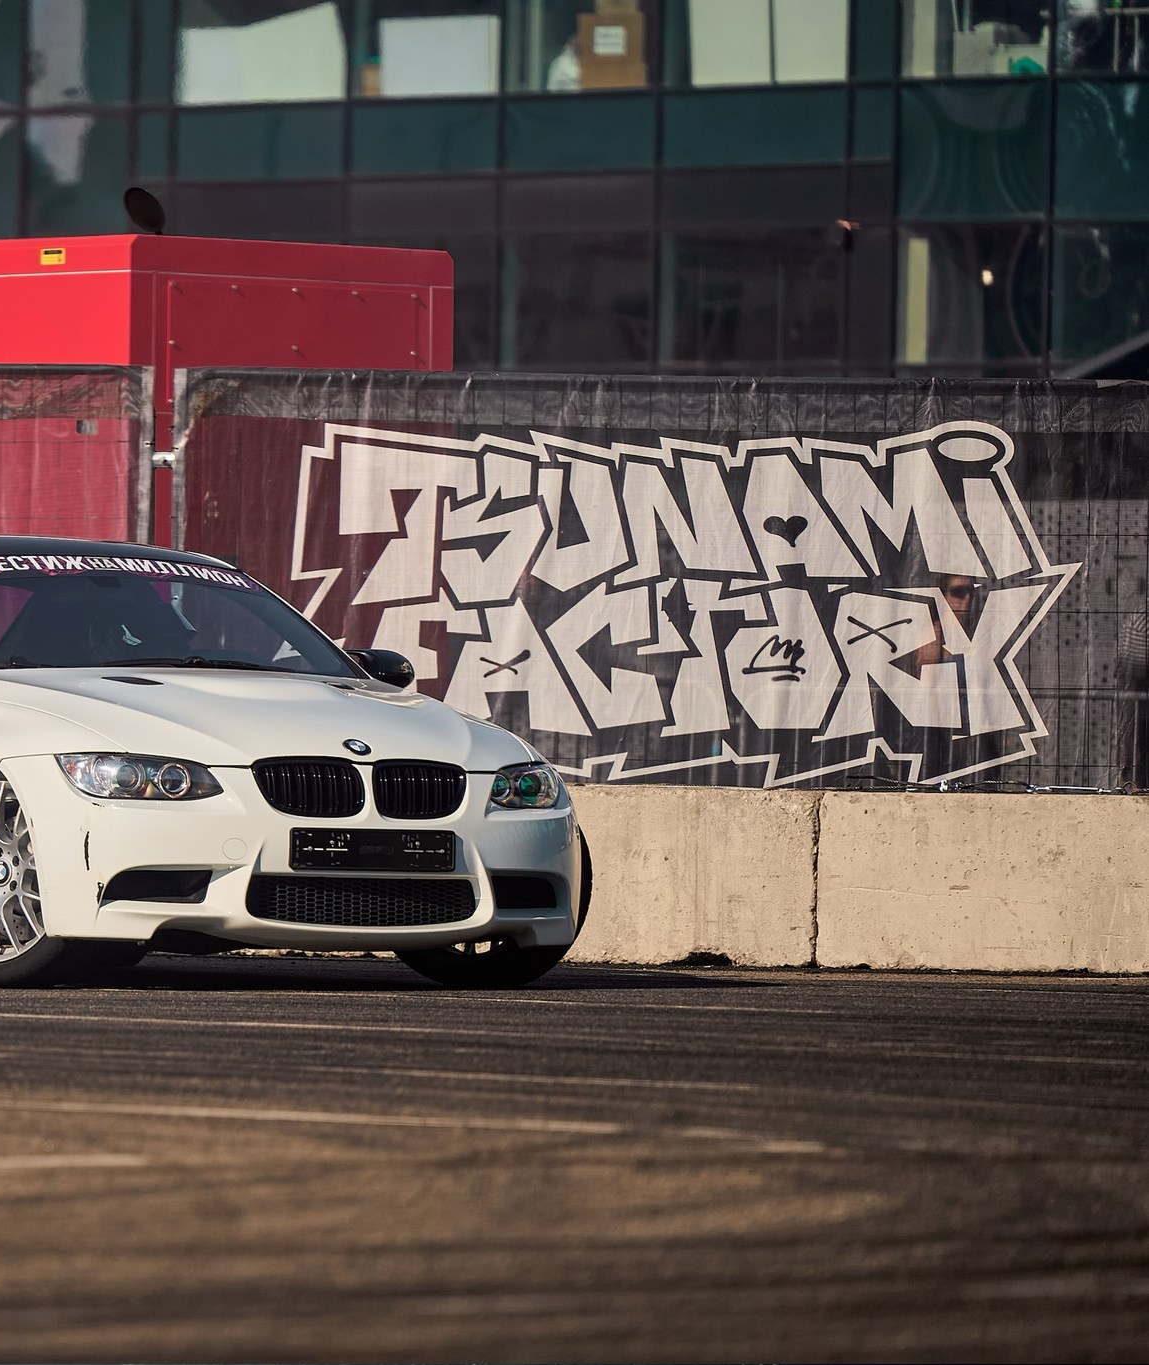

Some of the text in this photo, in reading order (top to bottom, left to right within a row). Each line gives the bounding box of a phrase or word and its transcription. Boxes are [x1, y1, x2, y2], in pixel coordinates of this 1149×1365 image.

[112, 558, 252, 589] МИЛЛИОН
[339, 426, 1033, 606] TSUNAMI
[371, 576, 1051, 737] FACTORY
